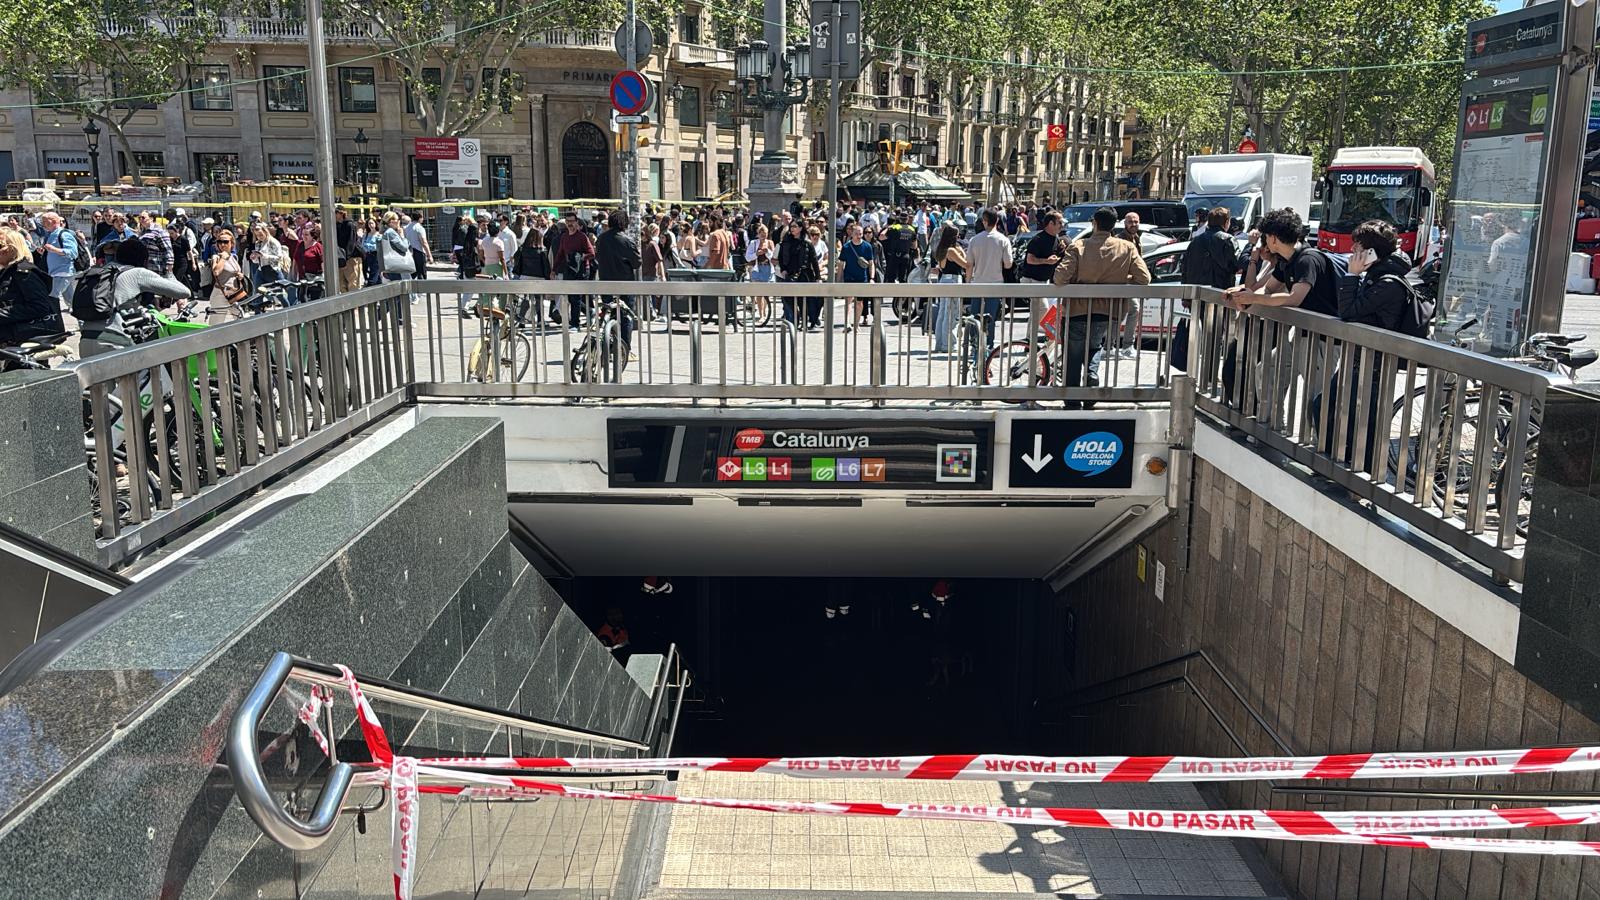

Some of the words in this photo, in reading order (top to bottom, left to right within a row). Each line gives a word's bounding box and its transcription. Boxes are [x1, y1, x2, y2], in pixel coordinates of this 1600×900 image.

[1516, 24, 1552, 41] Catalunya
[1479, 109, 1489, 124] L1
[1491, 107, 1504, 123] L3
[1340, 174, 1353, 185] 59
[1356, 174, 1403, 185] R.M.Cristina
[741, 436, 761, 444] TMB
[772, 431, 869, 451] Catalunya
[1073, 441, 1116, 452] HOLA
[745, 462, 765, 475] L3
[772, 462, 788, 475] L1
[839, 463, 858, 476] L6
[864, 463, 883, 476] L7
[984, 760, 1057, 773] PASAR
[1064, 762, 1096, 773] NO
[1127, 811, 1164, 827] NO
[1172, 812, 1256, 830] PASAR
